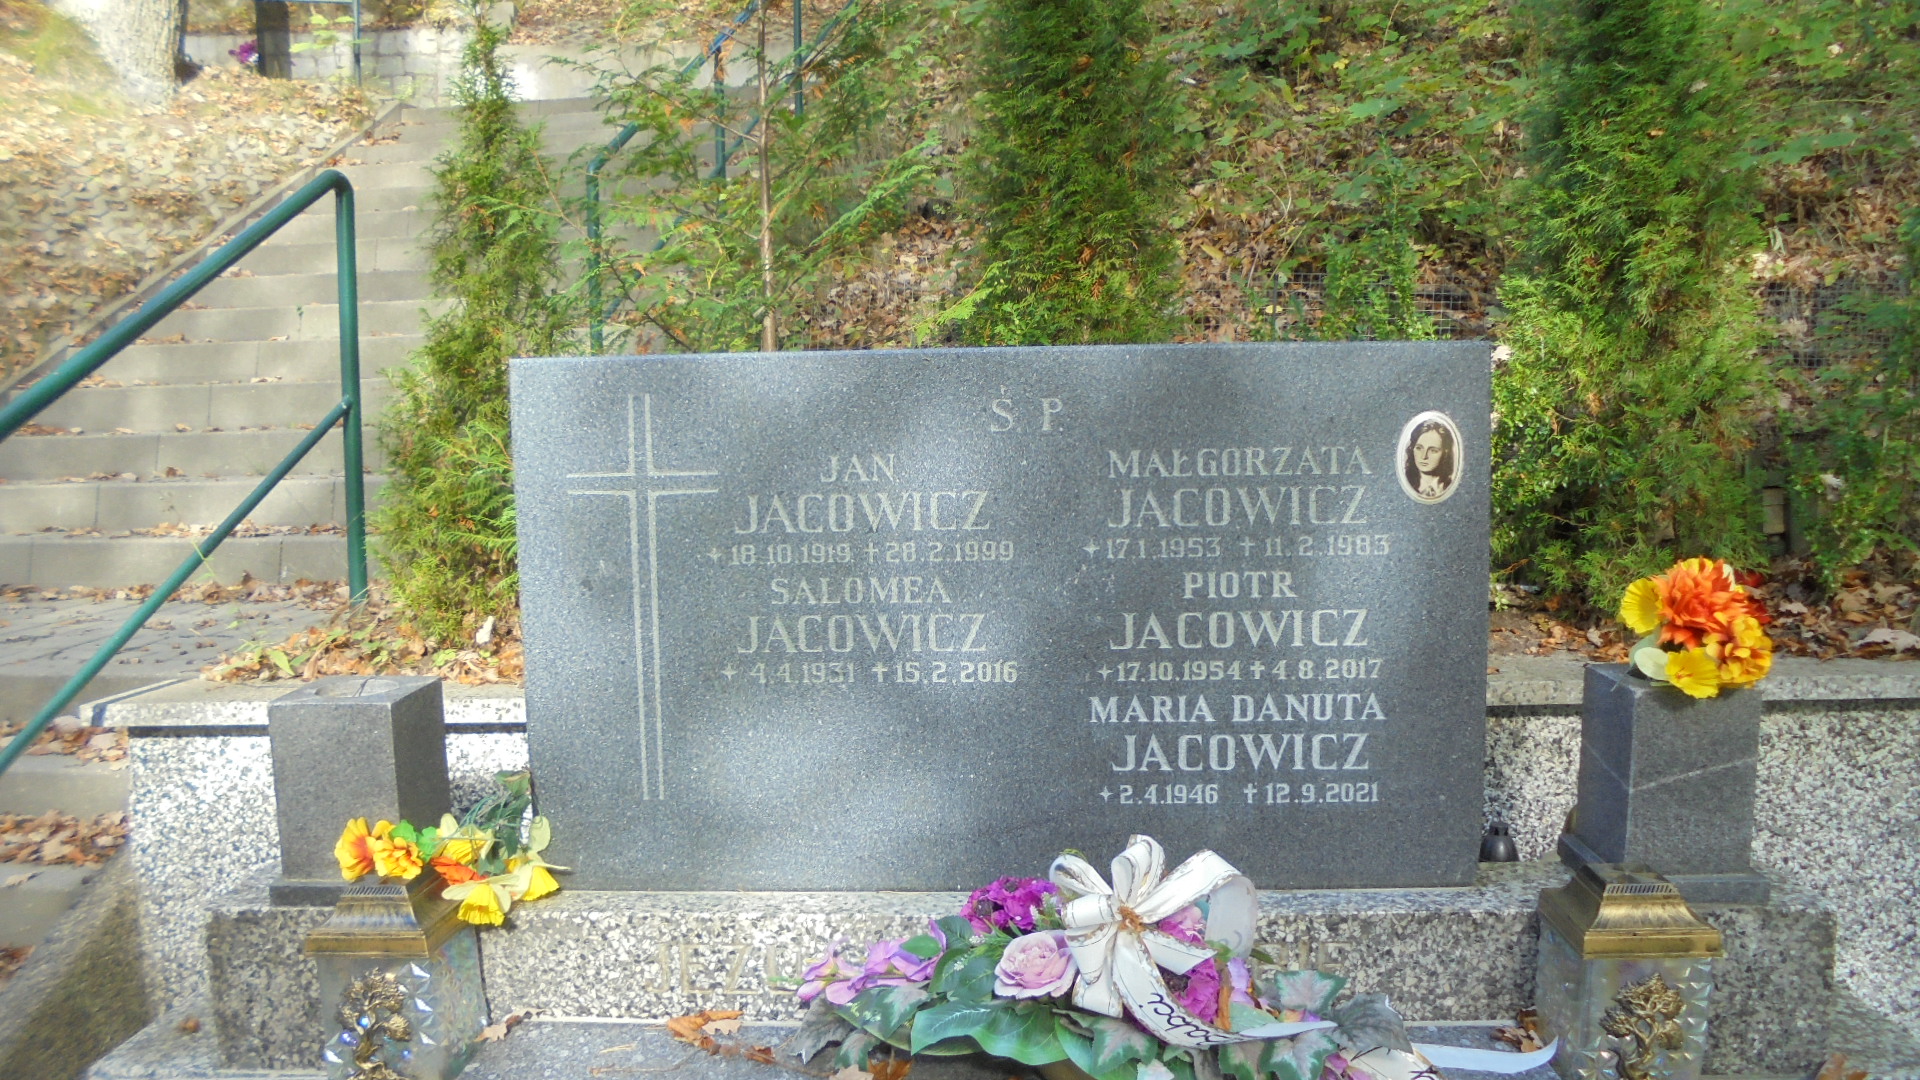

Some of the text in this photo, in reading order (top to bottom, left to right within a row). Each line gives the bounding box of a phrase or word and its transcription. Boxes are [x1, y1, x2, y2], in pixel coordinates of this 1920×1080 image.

[820, 453, 895, 483] JAN
[1108, 446, 1373, 478] MAŁGORZATA
[735, 490, 990, 534] JACOWICZ
[1108, 485, 1368, 528] JACOWICZ
[770, 576, 952, 605] SALOMEA
[1183, 570, 1298, 599] PIOTR
[737, 612, 987, 654] JACOWICZ
[1109, 608, 1369, 650] JACOWICZ
[1088, 692, 1387, 723] MARIA DANUTA
[1111, 731, 1370, 772] JACOWICZ
